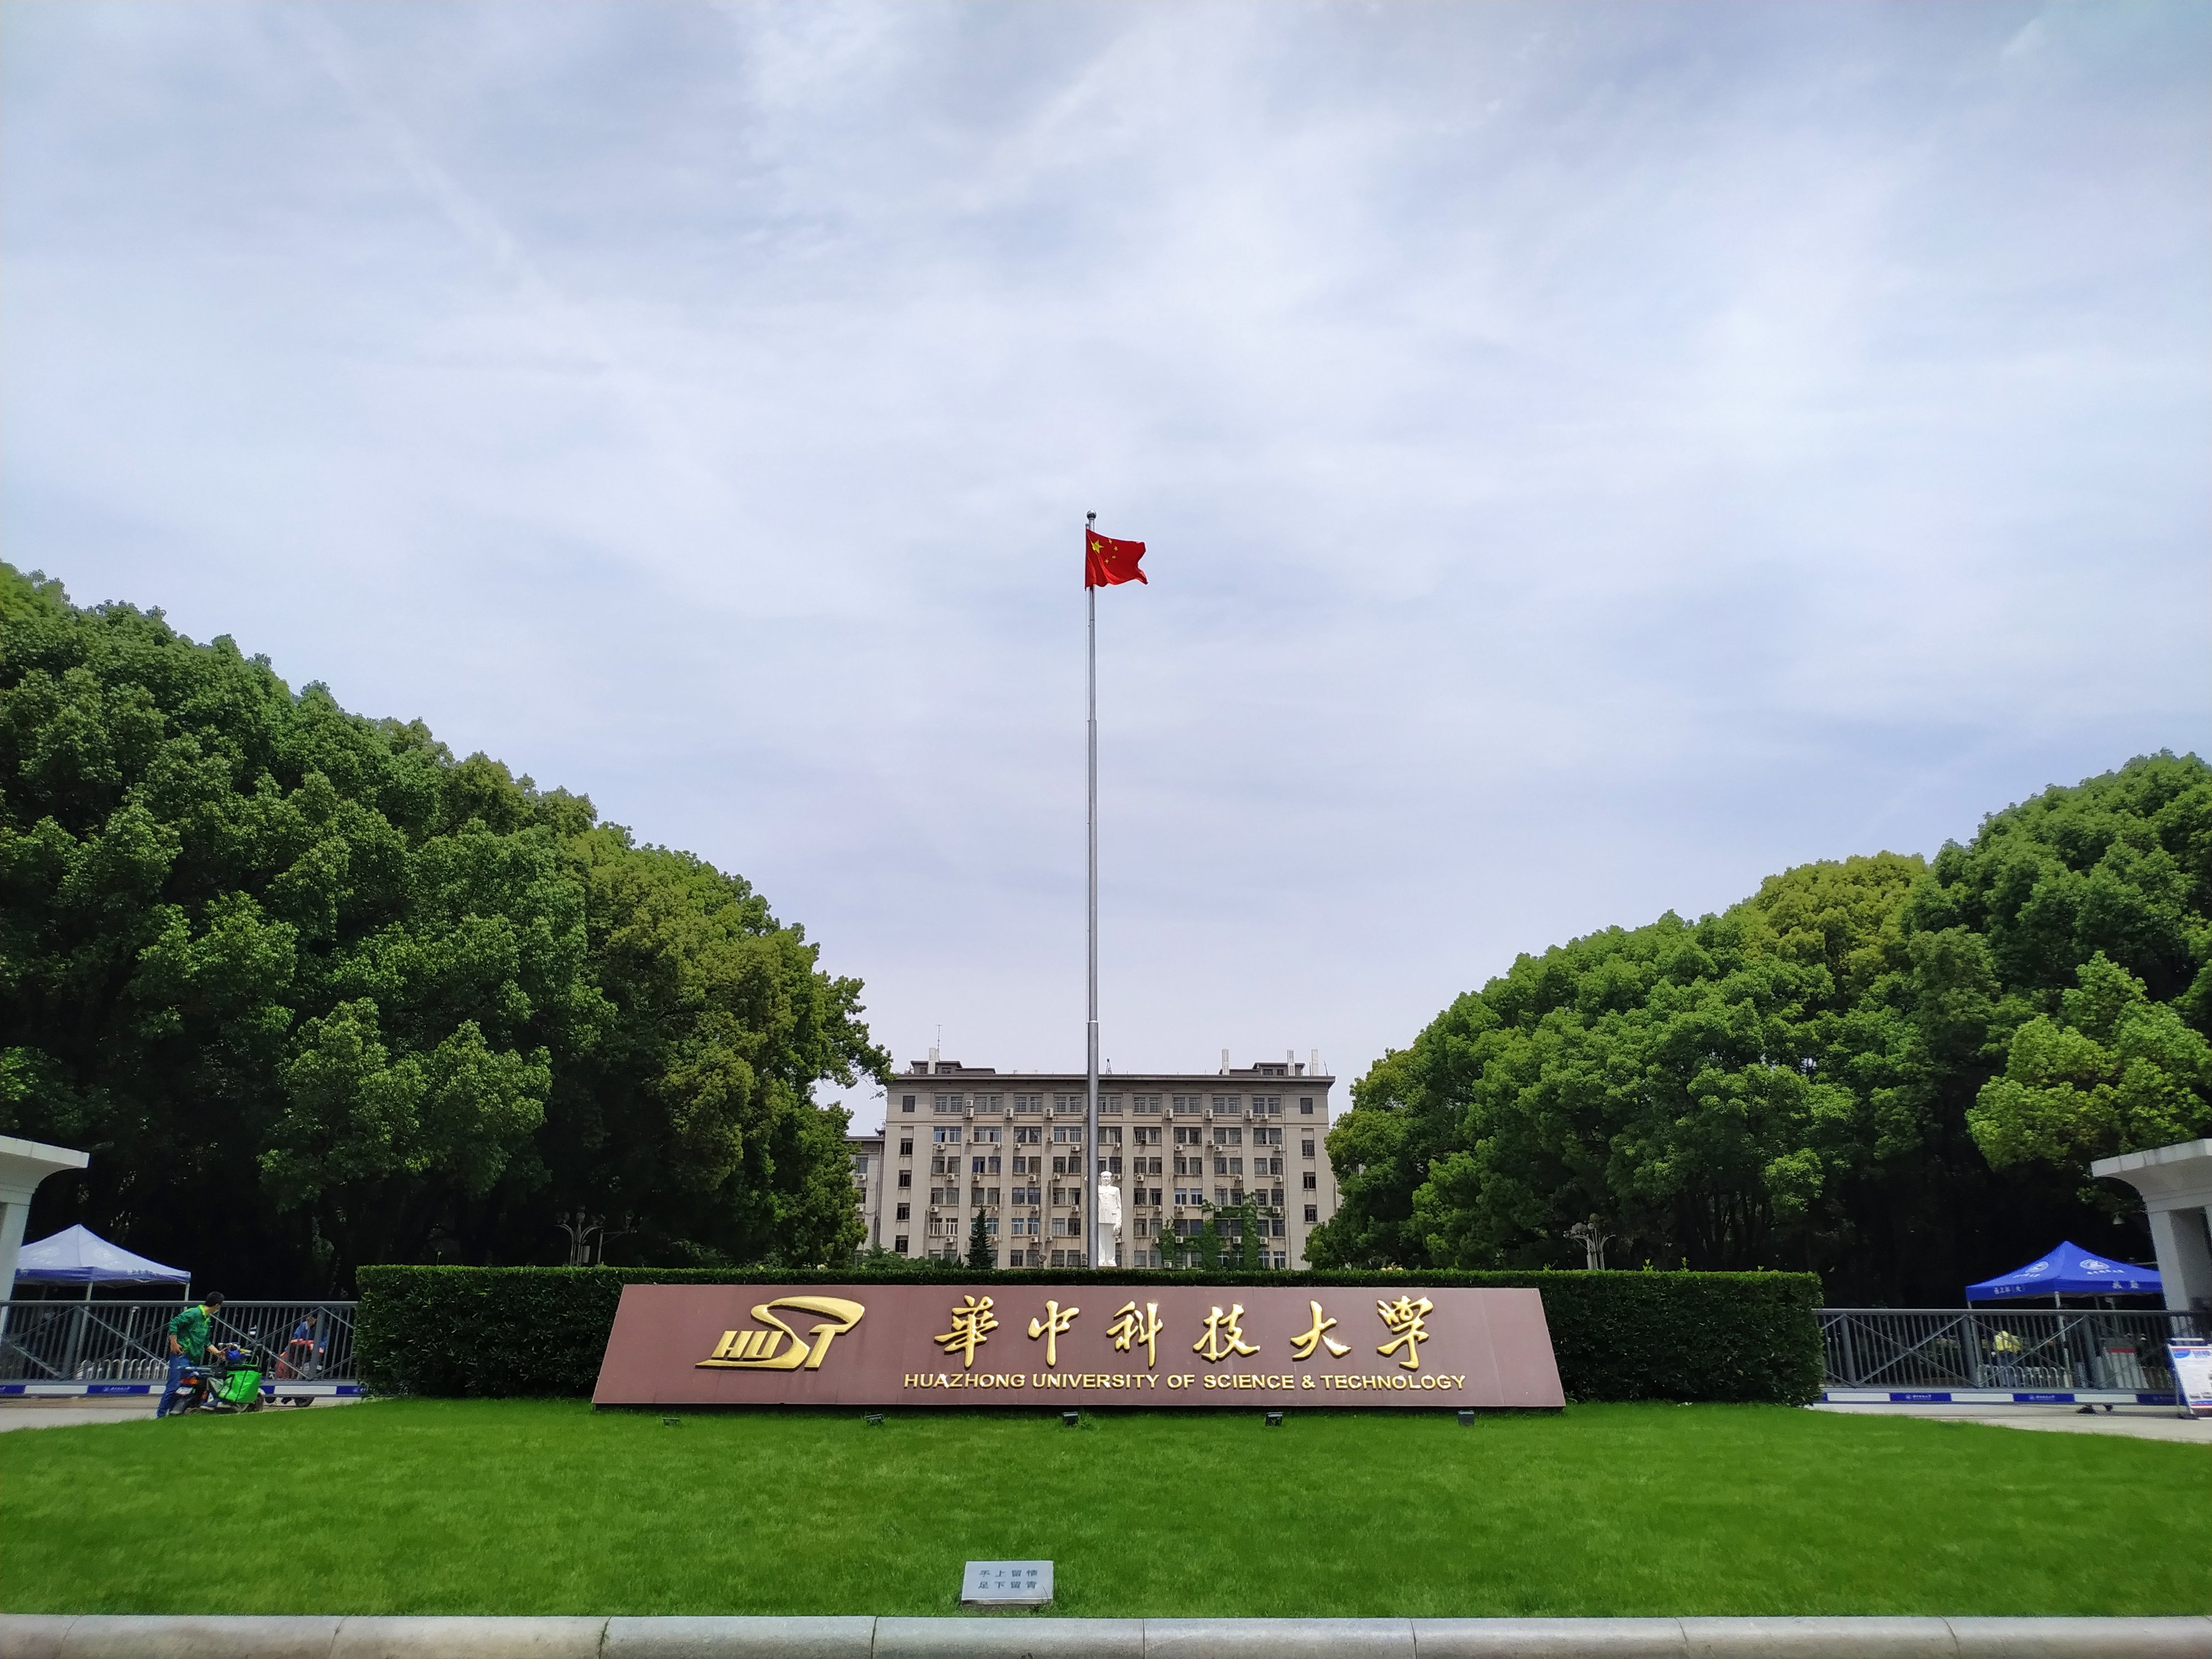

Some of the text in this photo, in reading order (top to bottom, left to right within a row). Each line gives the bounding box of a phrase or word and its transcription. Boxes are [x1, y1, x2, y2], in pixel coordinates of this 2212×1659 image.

[696, 1295, 866, 1370] HUST
[904, 1373, 1465, 1390] HUAZHONG UNIVERSITY OF SCIENCE & TECHNOLOGY
